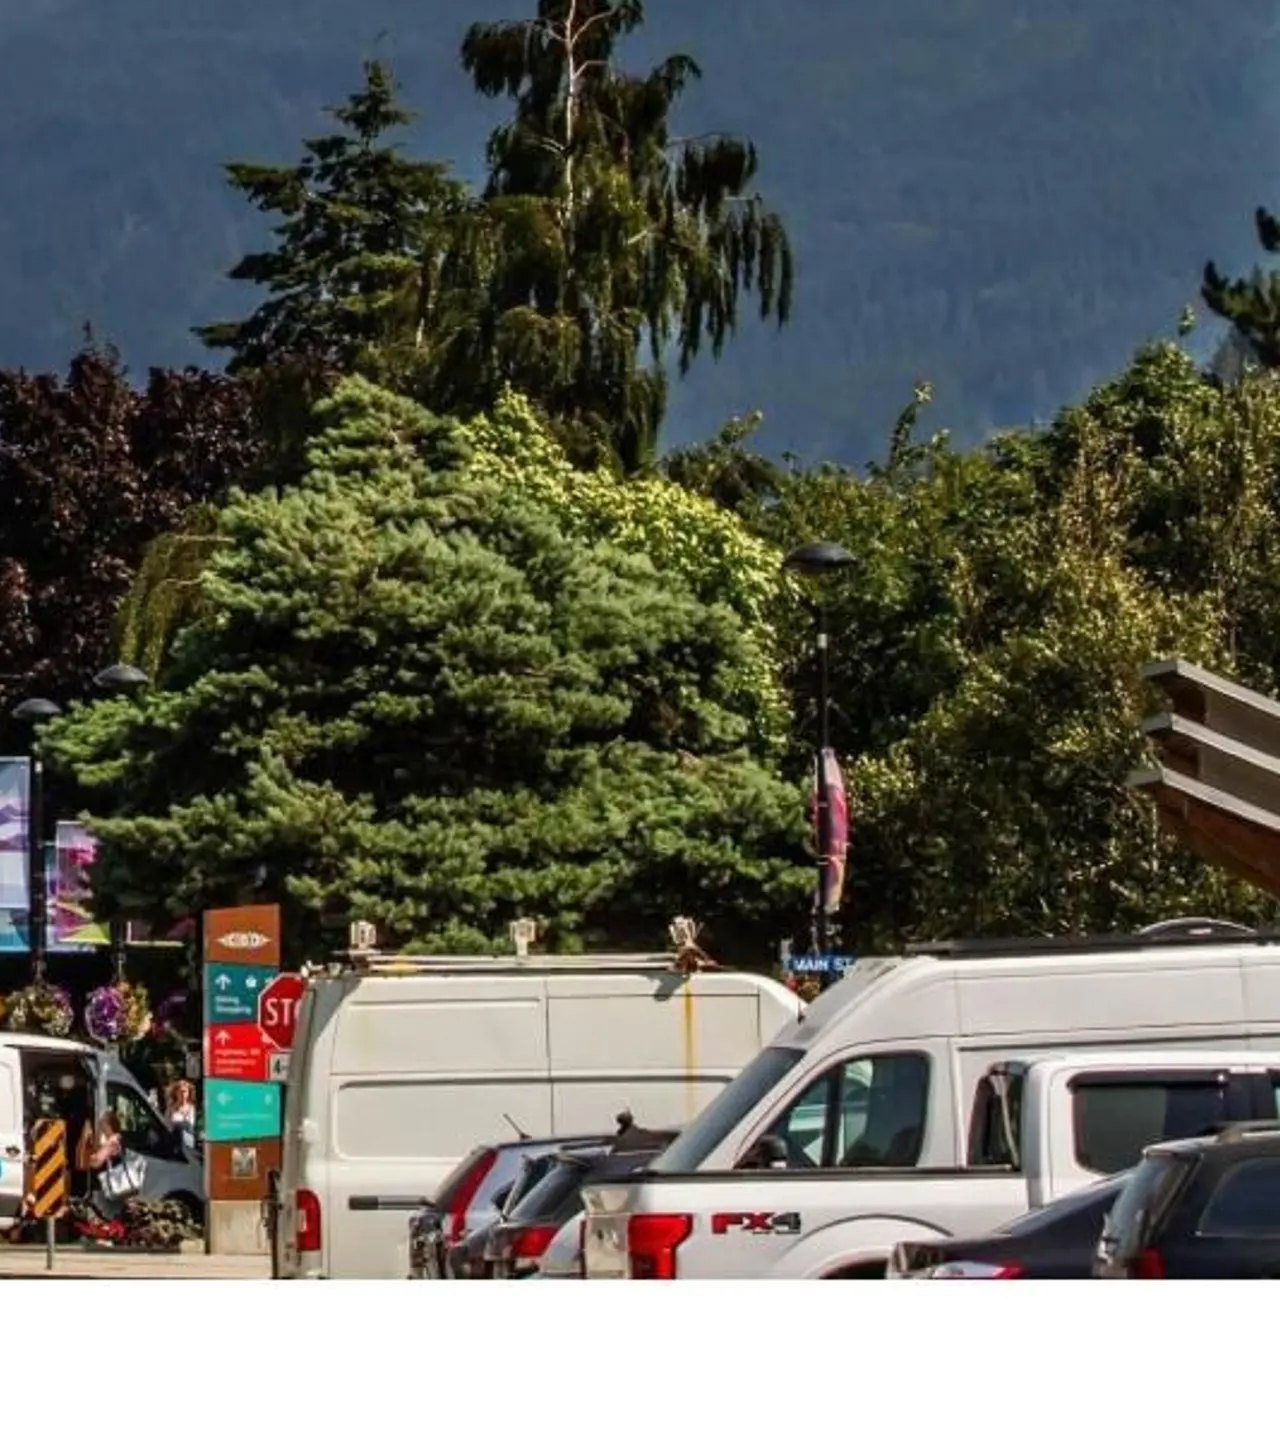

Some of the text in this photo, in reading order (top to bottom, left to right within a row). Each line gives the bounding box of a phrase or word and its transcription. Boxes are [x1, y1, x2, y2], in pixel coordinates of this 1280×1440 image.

[793, 957, 828, 971] MAIN
[264, 997, 301, 1027] ST
[711, 1212, 801, 1235] FX4
